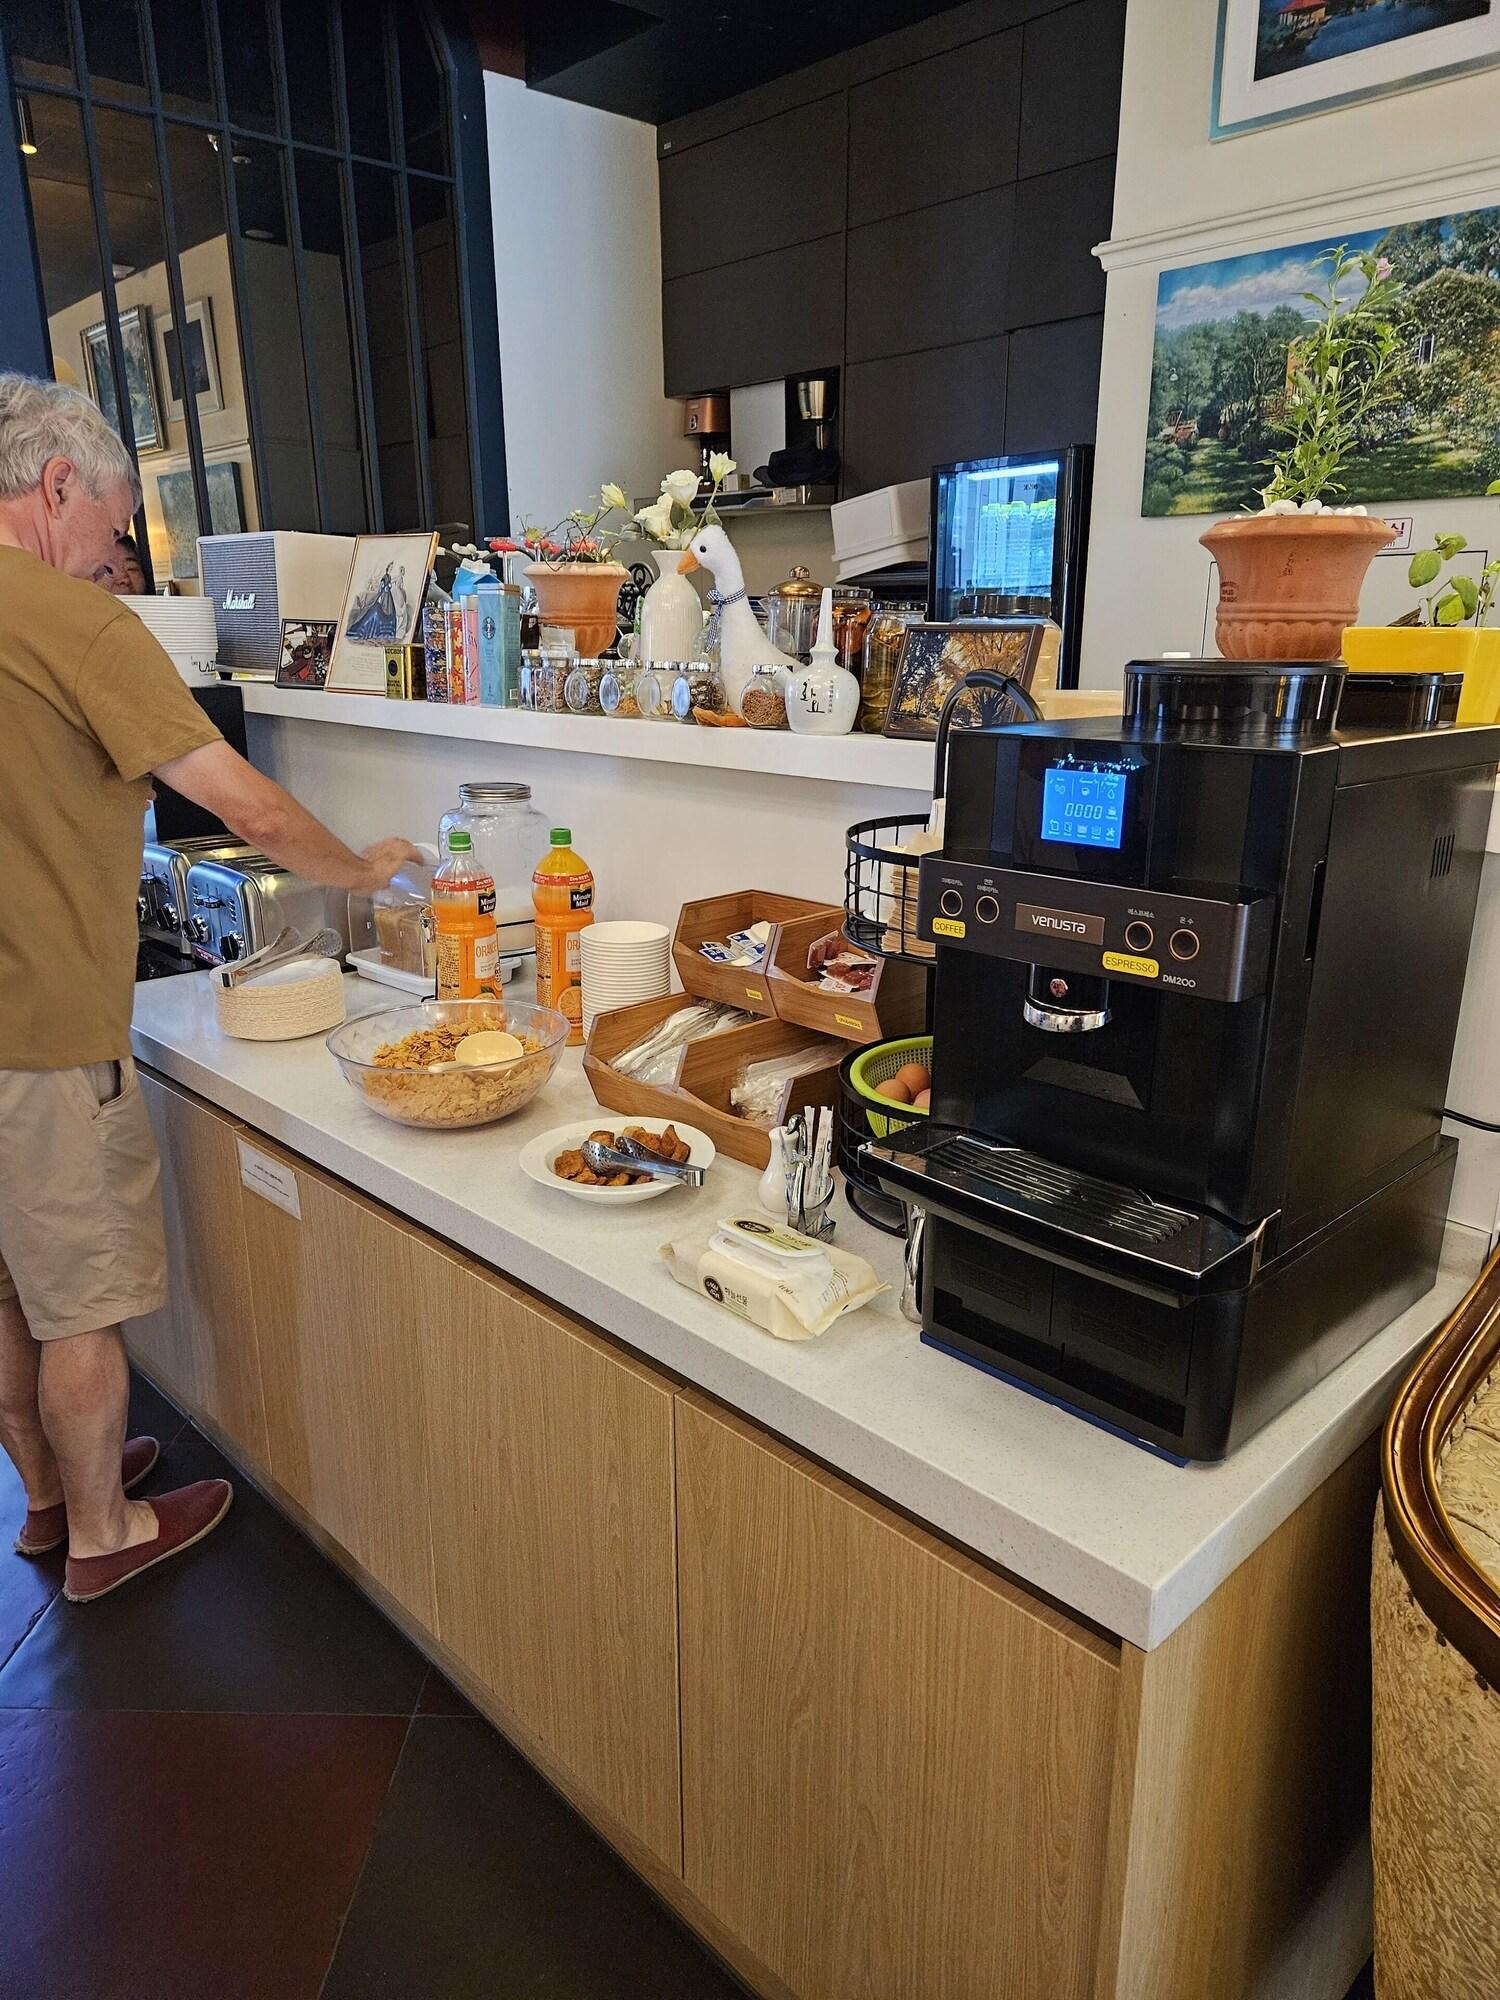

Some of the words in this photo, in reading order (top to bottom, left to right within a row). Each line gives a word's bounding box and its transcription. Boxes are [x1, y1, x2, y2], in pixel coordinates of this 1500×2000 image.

[222, 588, 255, 610] Marshall
[1064, 802, 1103, 820] 0000
[934, 921, 964, 935] COFFEE
[1105, 956, 1156, 974] ESPRESSO
[1162, 974, 1197, 988] DM200
